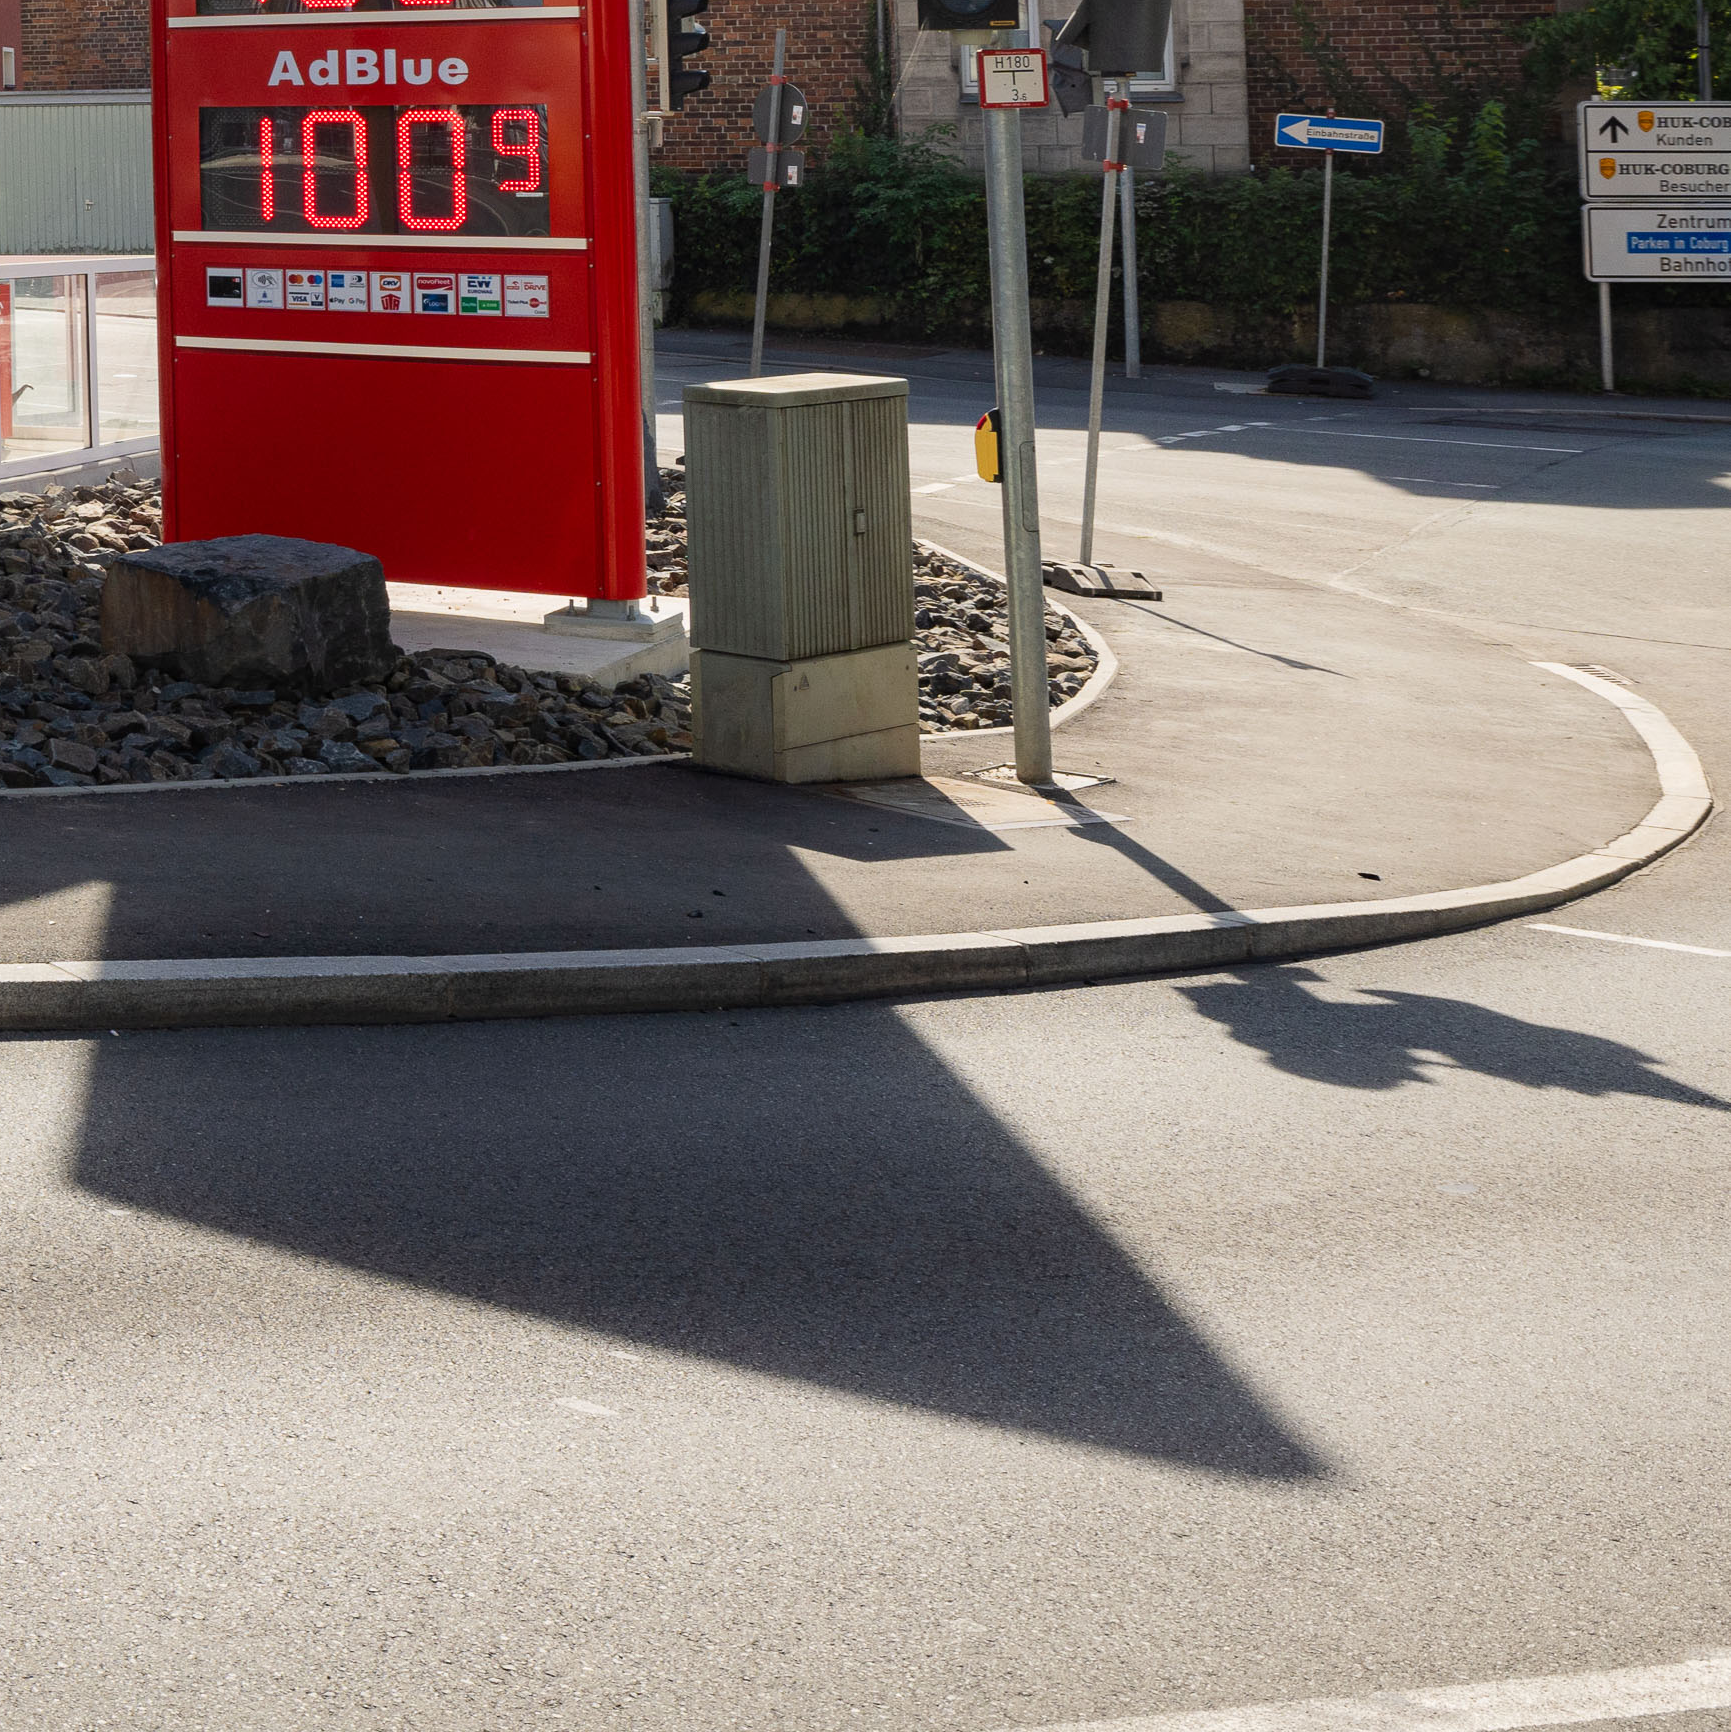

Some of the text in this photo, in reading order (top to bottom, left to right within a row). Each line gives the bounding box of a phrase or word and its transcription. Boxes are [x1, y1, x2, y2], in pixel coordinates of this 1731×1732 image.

[267, 48, 469, 87] AdBlue
[1306, 128, 1376, 141] Einbahnstraße
[1656, 134, 1713, 146] Kunden
[1618, 163, 1730, 175] HUK-COBURG
[1630, 236, 1730, 252] Parken in Coburg
[1659, 257, 1731, 272] Bahnho
